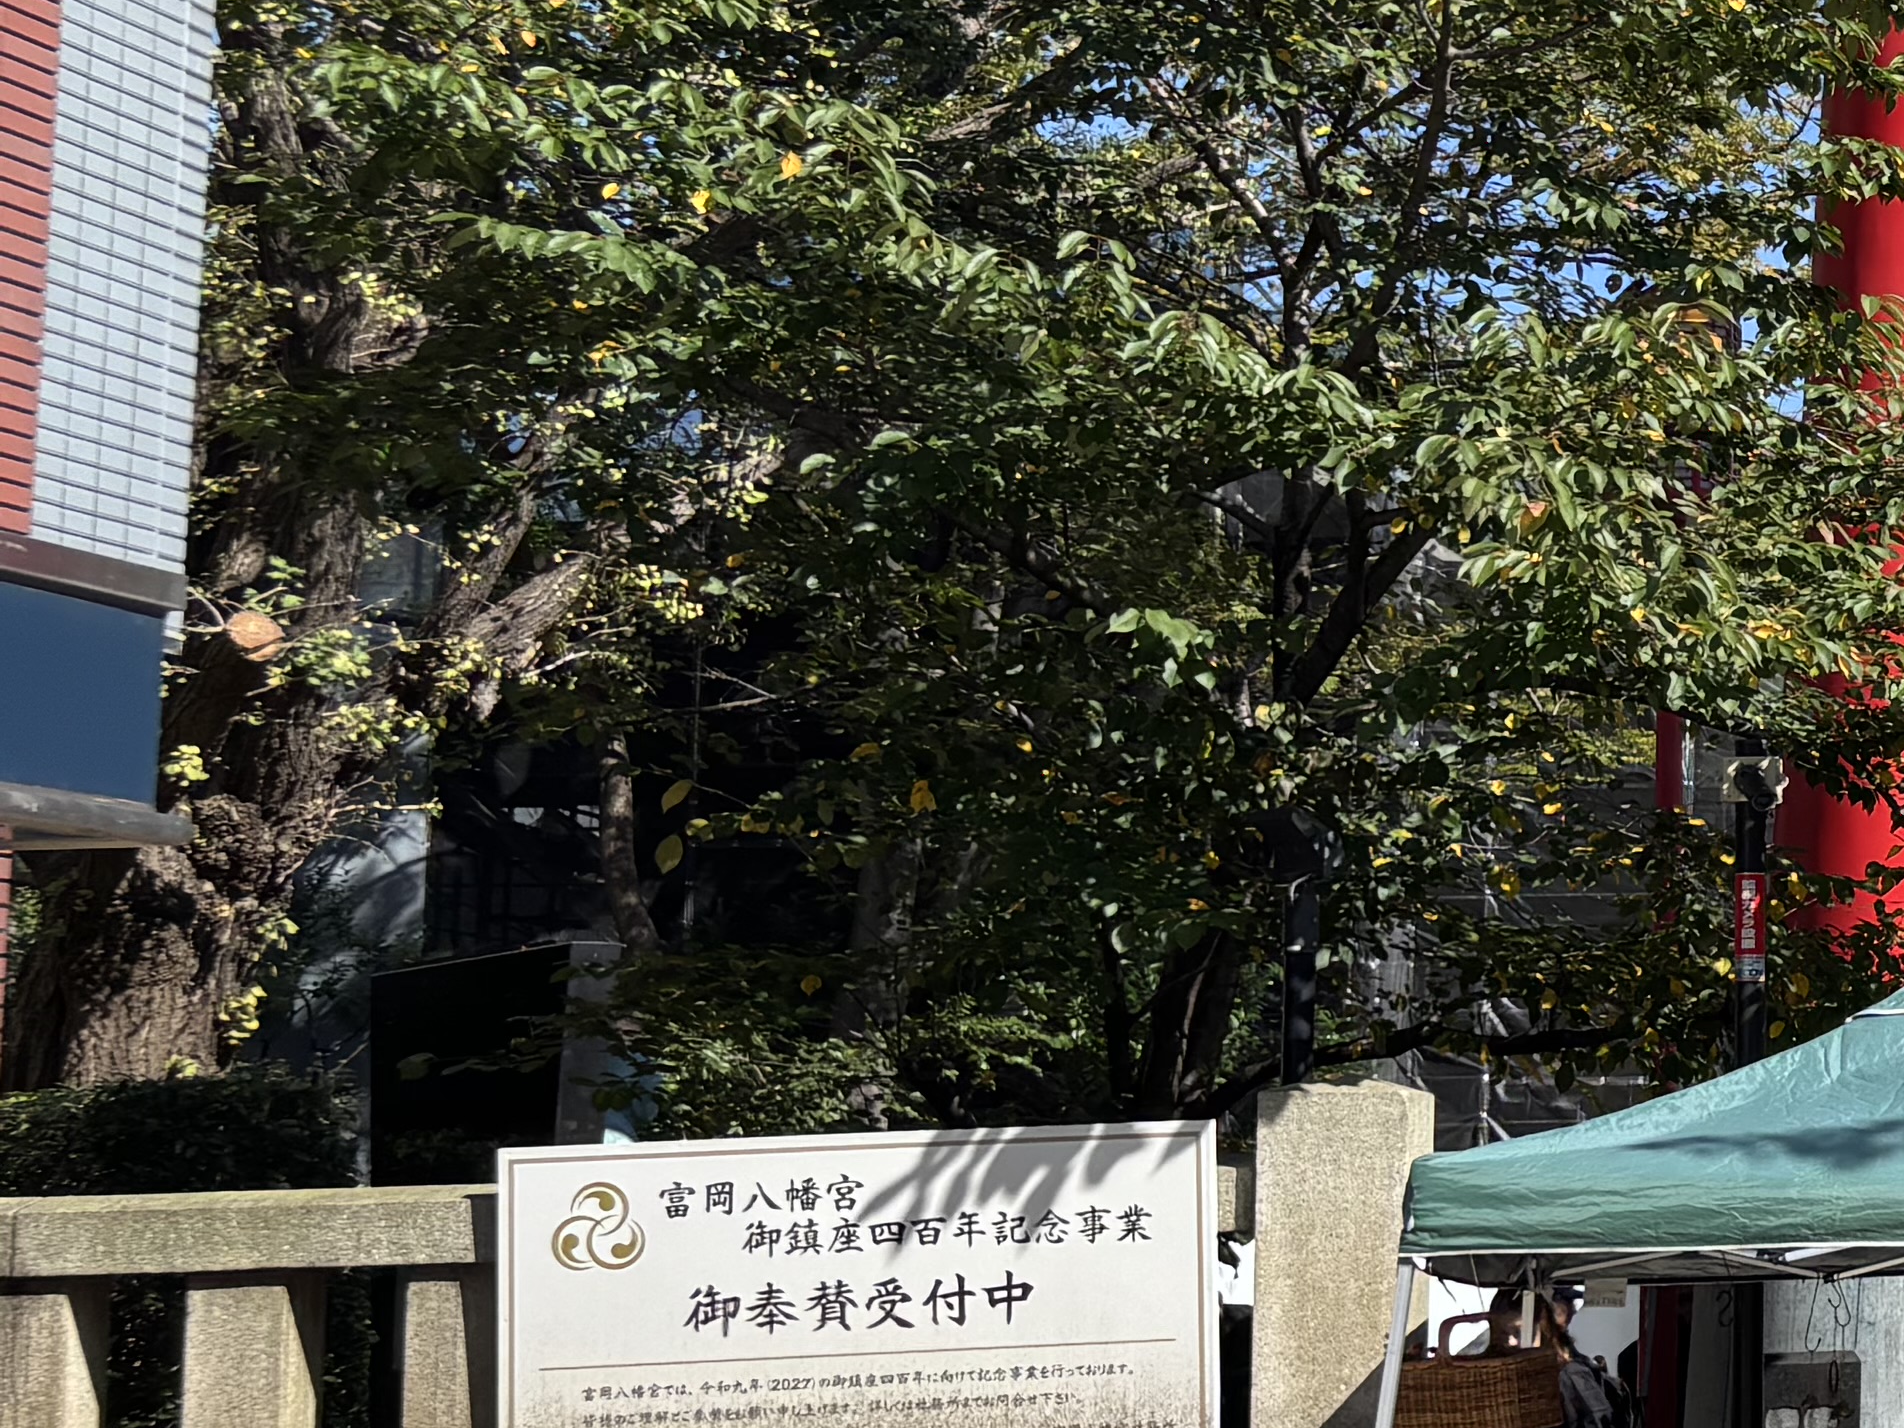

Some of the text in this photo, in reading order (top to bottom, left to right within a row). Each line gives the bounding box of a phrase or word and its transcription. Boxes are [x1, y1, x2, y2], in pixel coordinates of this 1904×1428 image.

[658, 1174, 864, 1219] 富岡八幡宮
[742, 1203, 1153, 1259] 御鎮座四百年記念事業
[683, 1270, 1036, 1337] 御奉賛受付中
